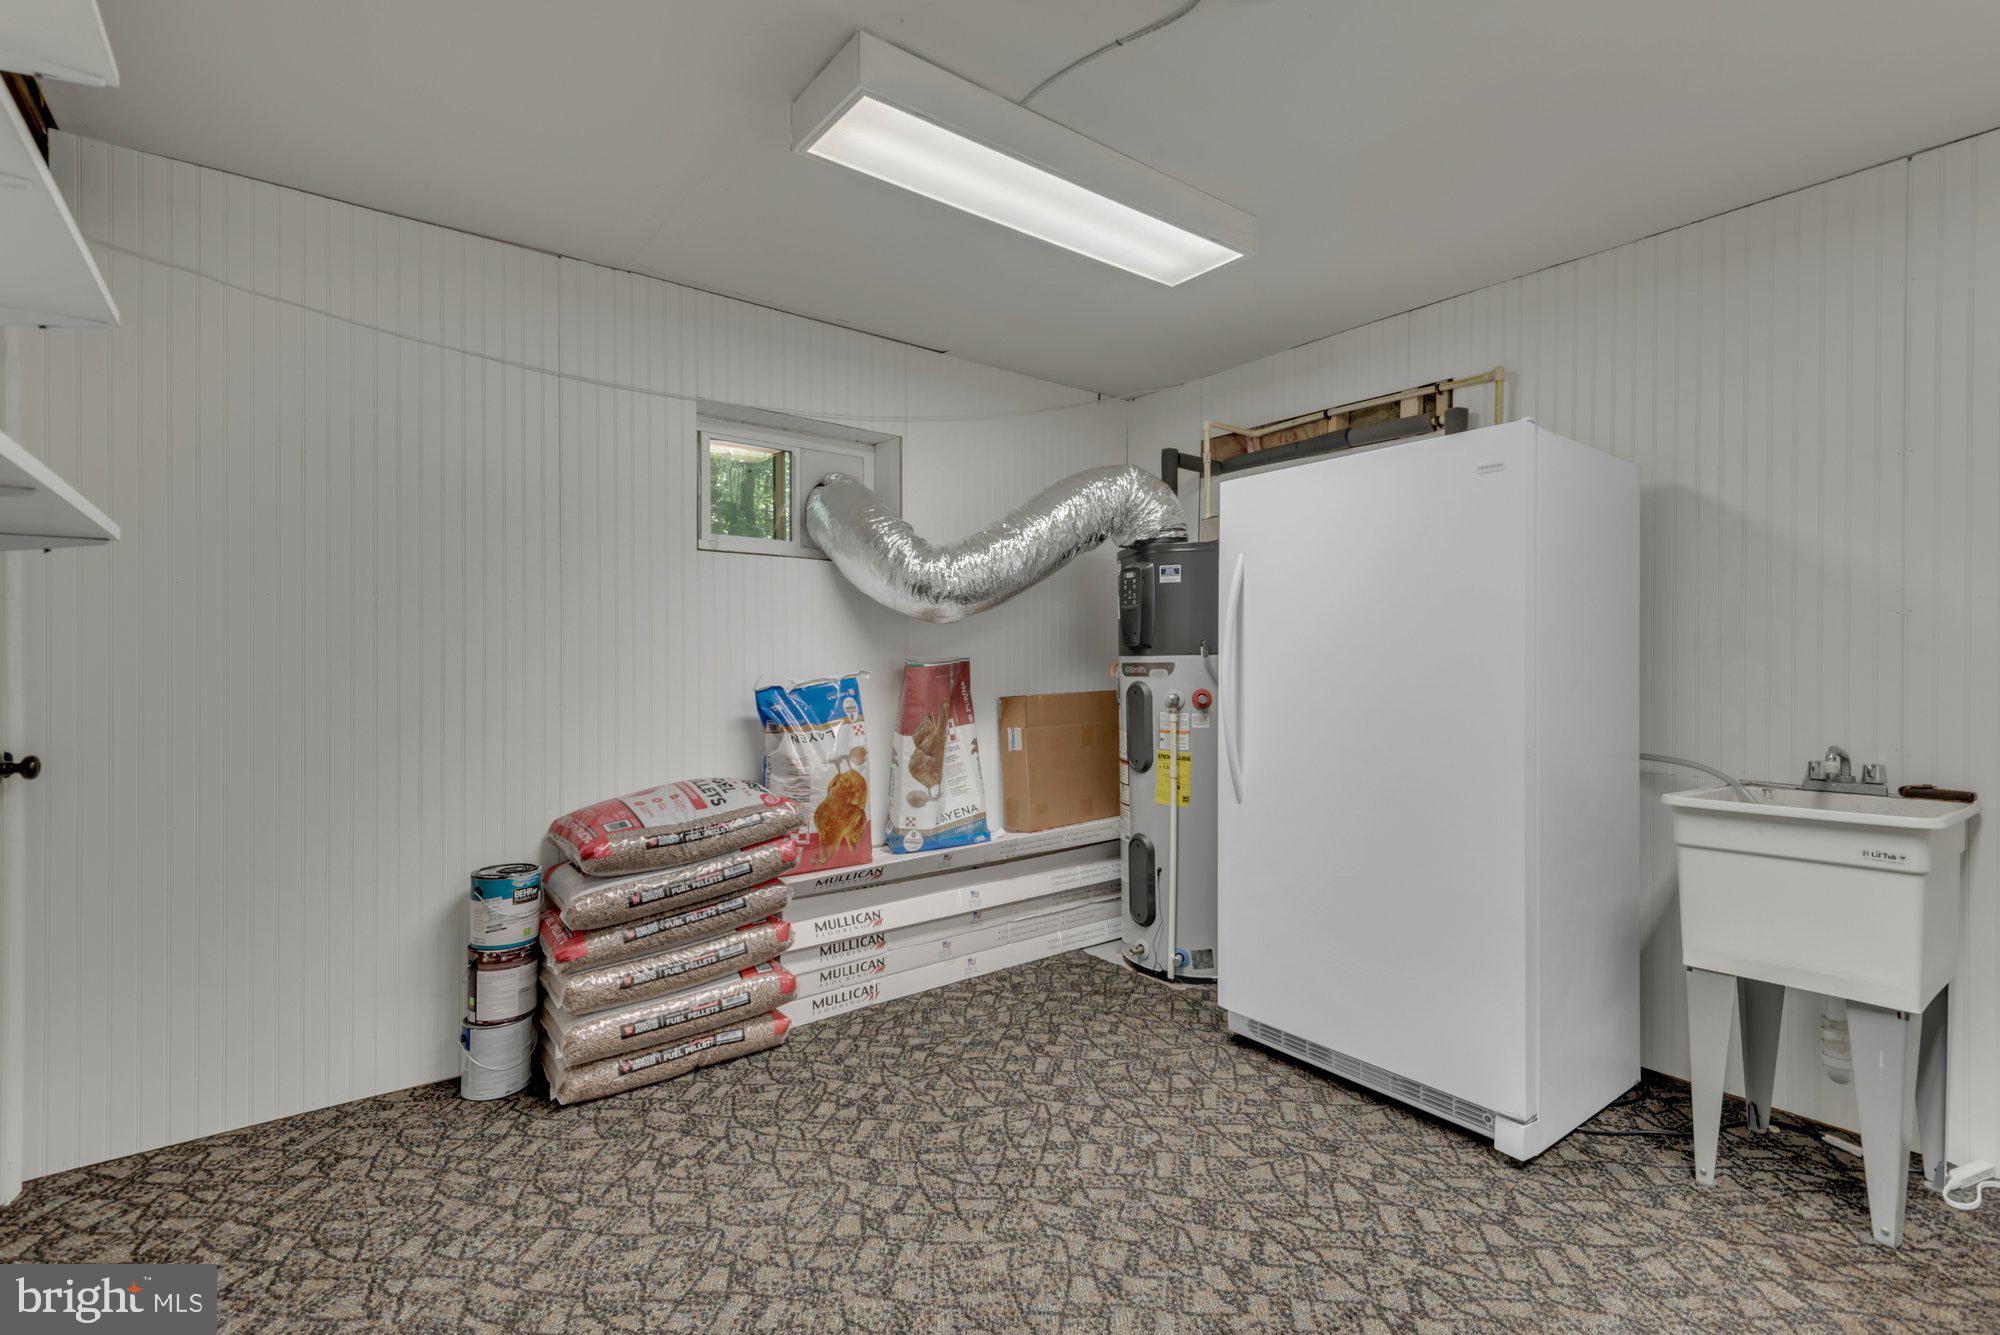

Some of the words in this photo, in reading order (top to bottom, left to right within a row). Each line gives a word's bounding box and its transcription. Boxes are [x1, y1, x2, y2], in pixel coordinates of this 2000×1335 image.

[1884, 852, 1897, 860] Tub
[814, 866, 885, 888] MULLICAN
[814, 910, 882, 933] MULLICAN
[820, 932, 886, 958] MULLICAN
[820, 957, 886, 983] MULLICAN
[812, 984, 879, 1010] MULLICAN
[666, 1014, 687, 1026] FUEL
[688, 1005, 720, 1020] PELLETS
[664, 1052, 684, 1062] FUEL
